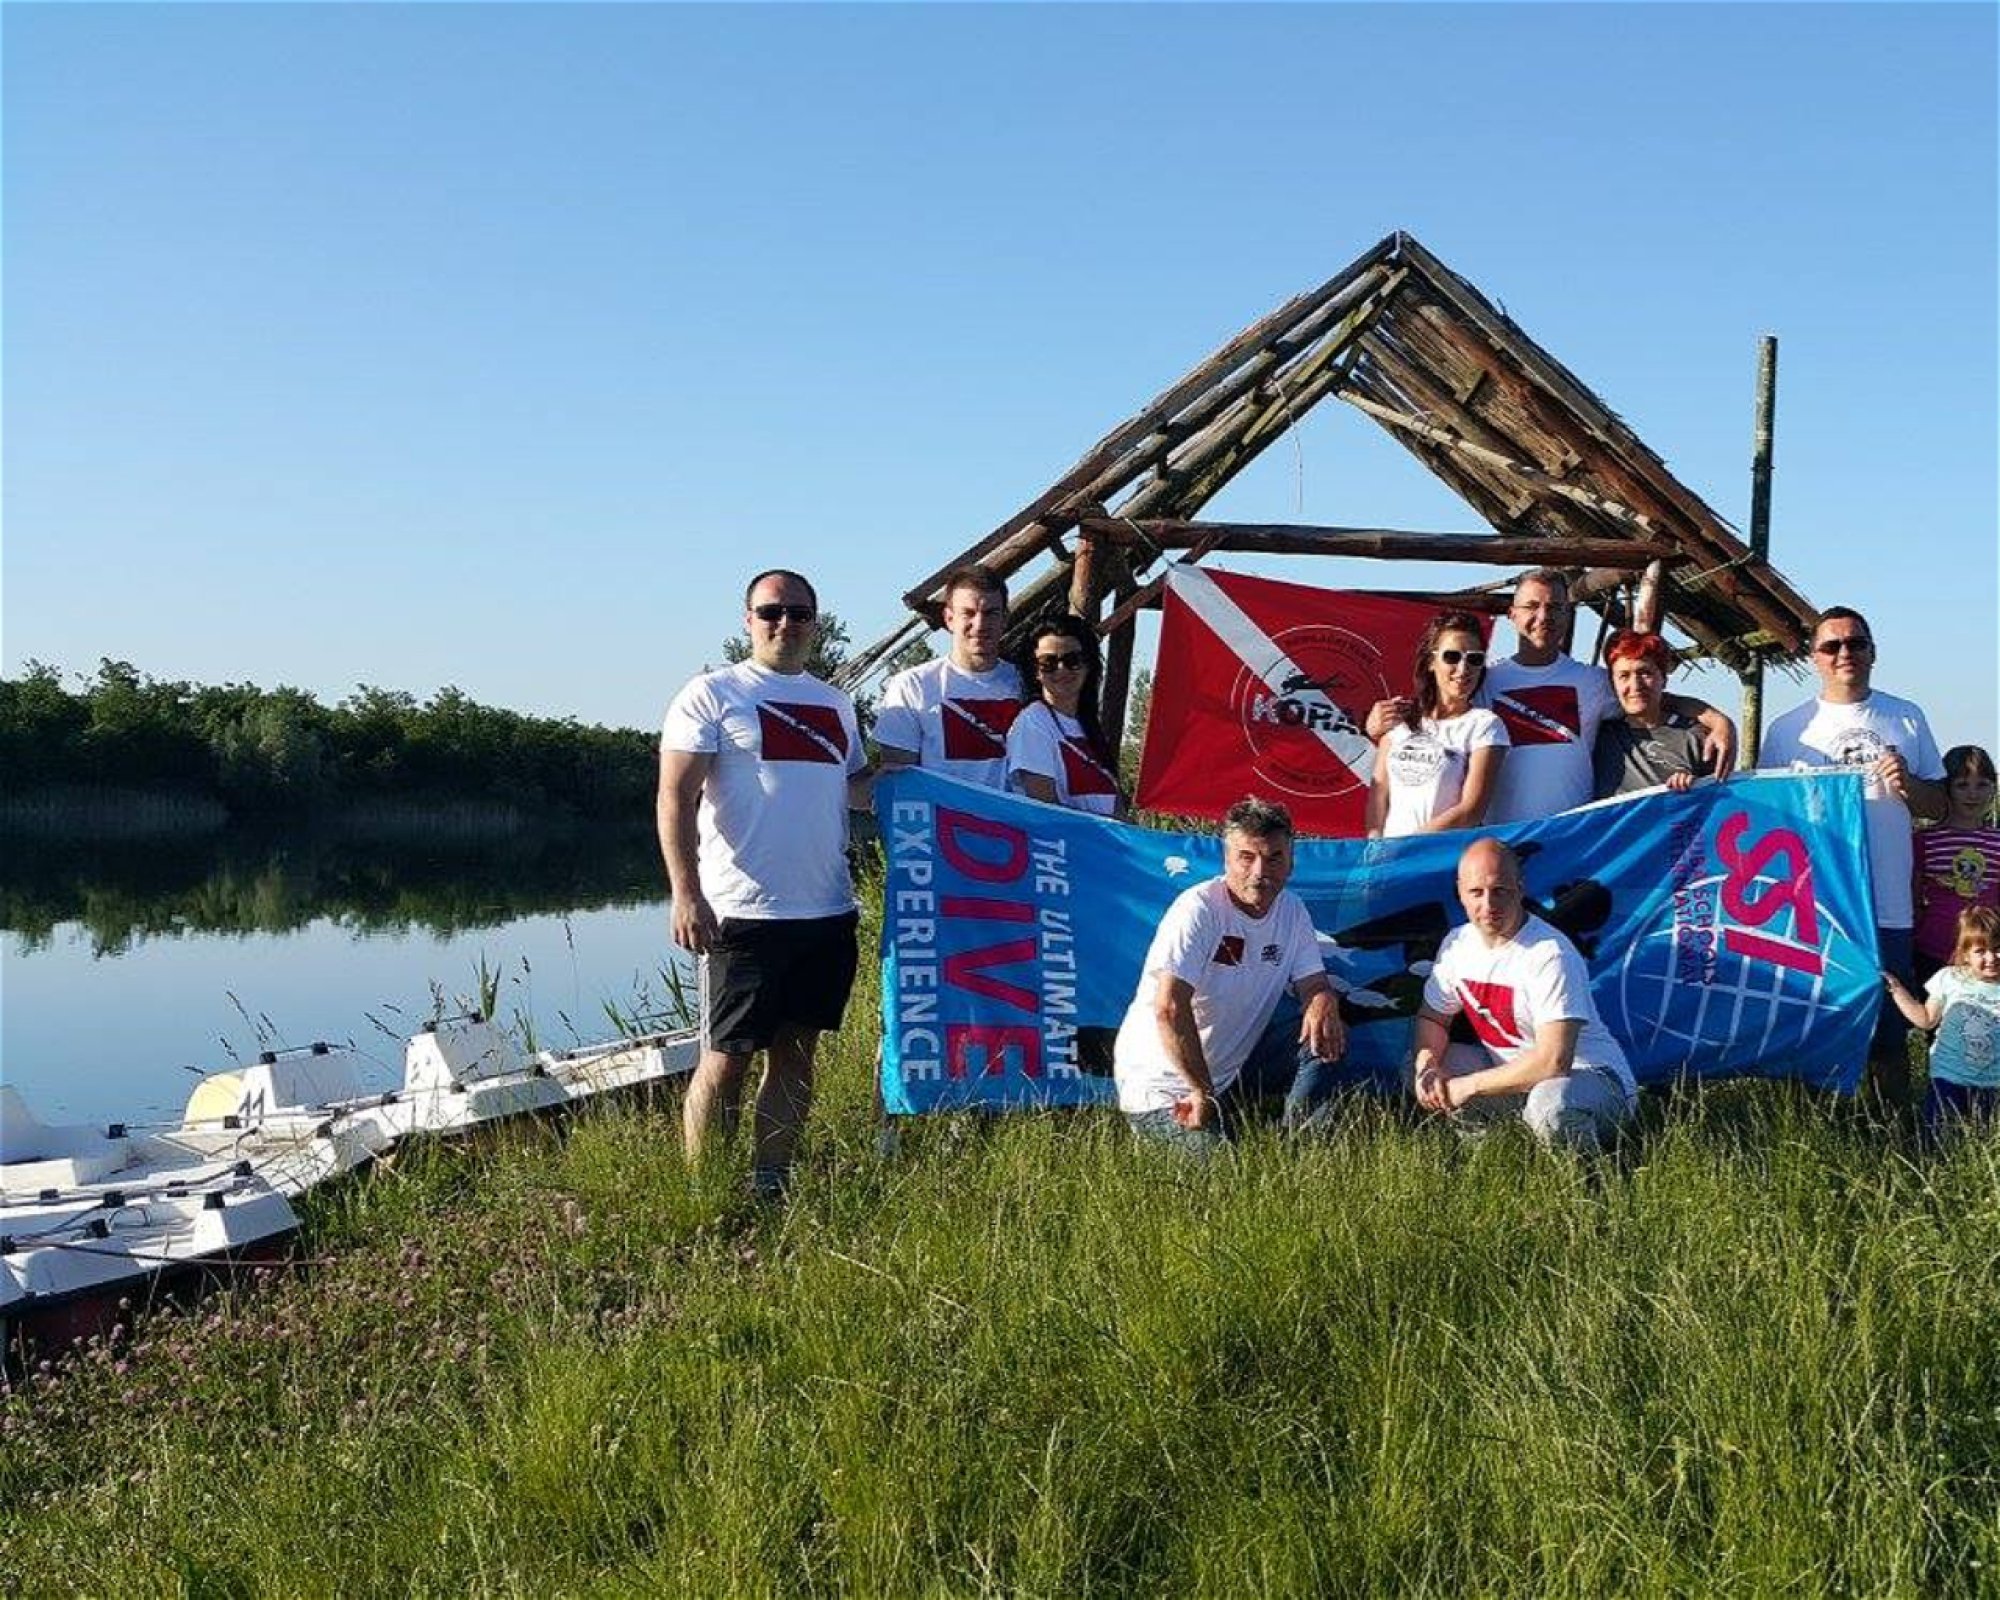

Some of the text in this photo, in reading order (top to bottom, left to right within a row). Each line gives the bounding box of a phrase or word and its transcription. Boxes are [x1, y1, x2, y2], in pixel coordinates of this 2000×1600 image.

[1252, 692, 1364, 736] KORA
[891, 801, 942, 1082] EXPERIENCE
[936, 805, 1040, 1082] DIVE
[1033, 838, 1081, 1080] THE ULTIMATE
[1715, 811, 1823, 976] SSI
